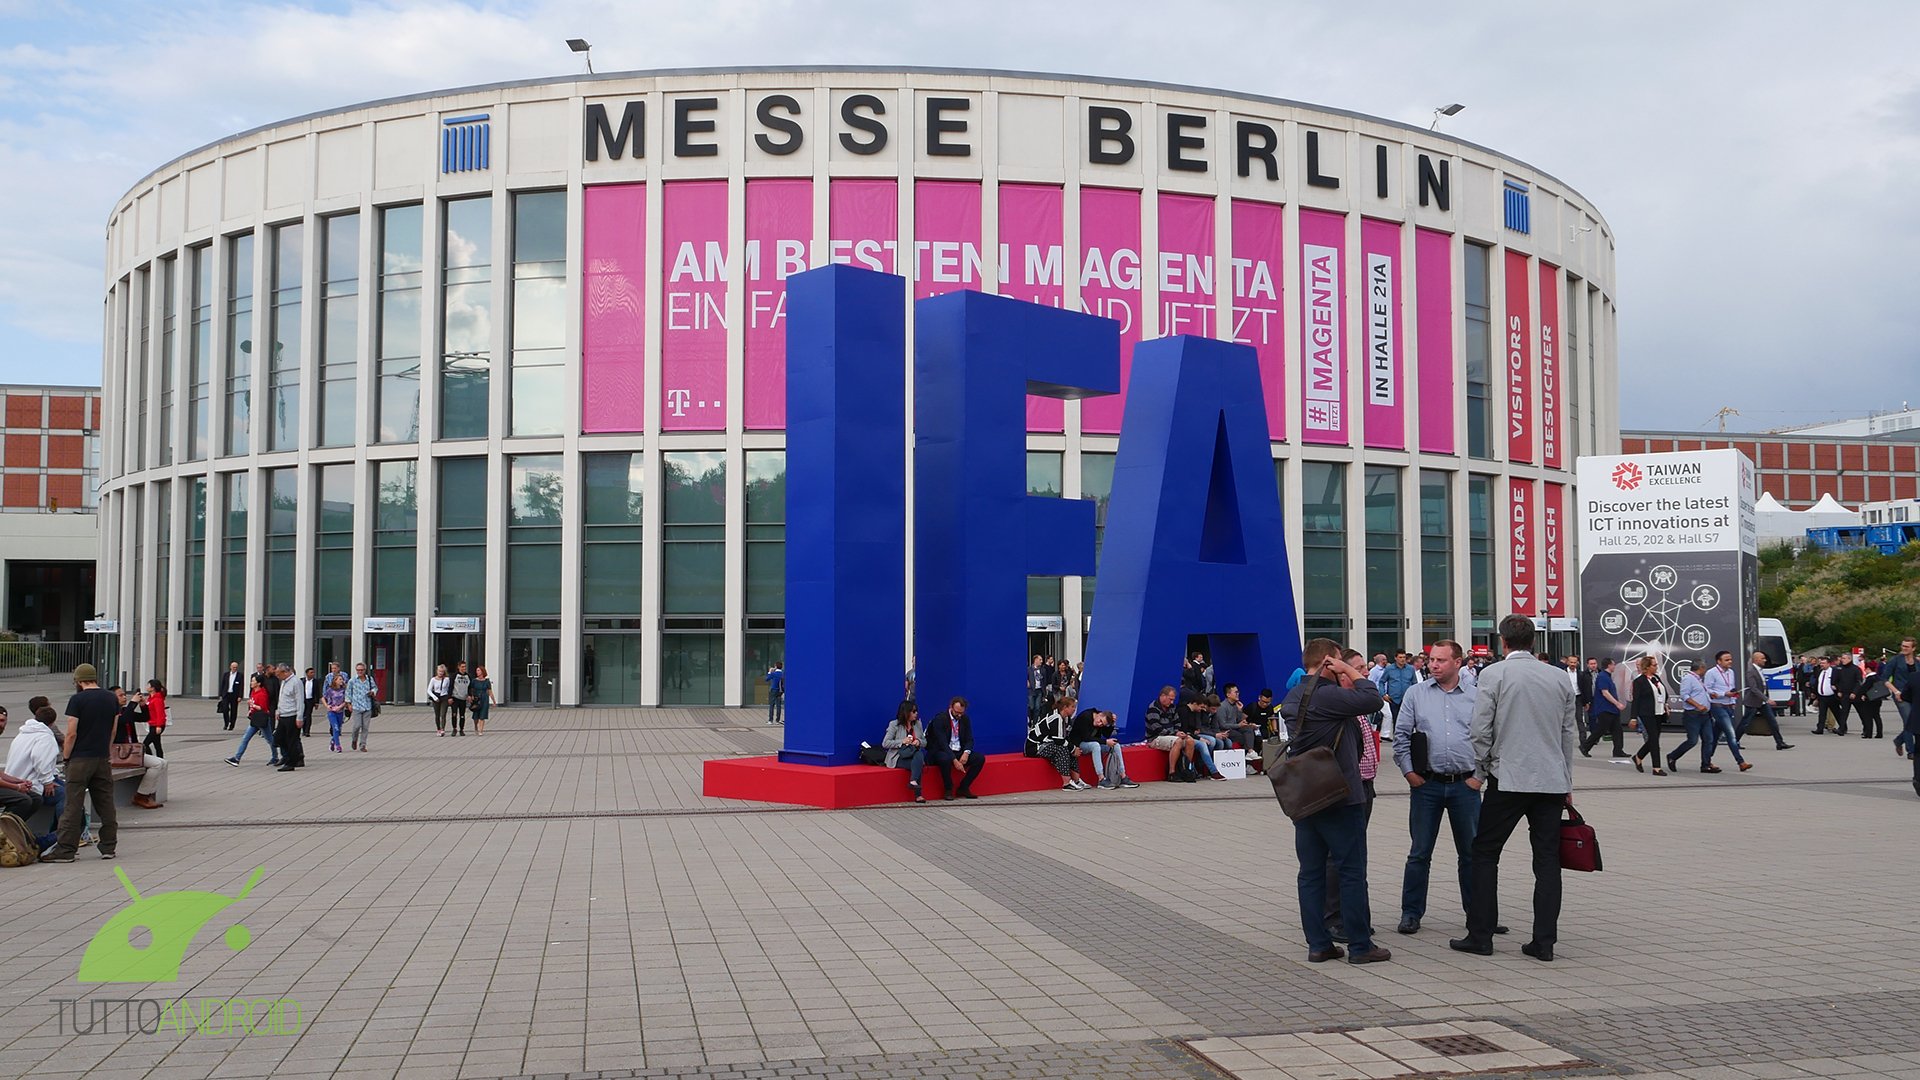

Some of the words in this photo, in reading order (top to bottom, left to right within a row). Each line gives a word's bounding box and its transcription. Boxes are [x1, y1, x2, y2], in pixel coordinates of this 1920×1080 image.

[585, 94, 972, 162] MESSE
[1089, 105, 1451, 212] BERLIN
[669, 239, 761, 283] AM
[1024, 244, 1277, 301] MAGENTA
[1373, 263, 1387, 298] 21A
[1374, 303, 1389, 370] HALLE
[1375, 377, 1389, 398] IN
[1510, 315, 1523, 438] VISITORS
[1543, 325, 1554, 459] BESUCHER
[1646, 463, 1701, 477] TAIWAN
[1649, 476, 1702, 486] EXCELLENCE
[779, 264, 1302, 767] IFA
[1513, 487, 1526, 578] TRADE
[1588, 500, 1653, 514] Discover
[1656, 498, 1682, 511] the
[1685, 496, 1730, 510] latest
[1589, 517, 1614, 531] ICT
[1618, 515, 1710, 530] innovations
[1713, 514, 1730, 528] at
[1546, 507, 1557, 580] FACH
[1599, 536, 1622, 546] Hall
[1624, 535, 1641, 547] 25,
[1643, 534, 1664, 545] 202
[1666, 534, 1676, 545] &
[1678, 533, 1702, 544] Hall
[1704, 533, 1720, 543] S7
